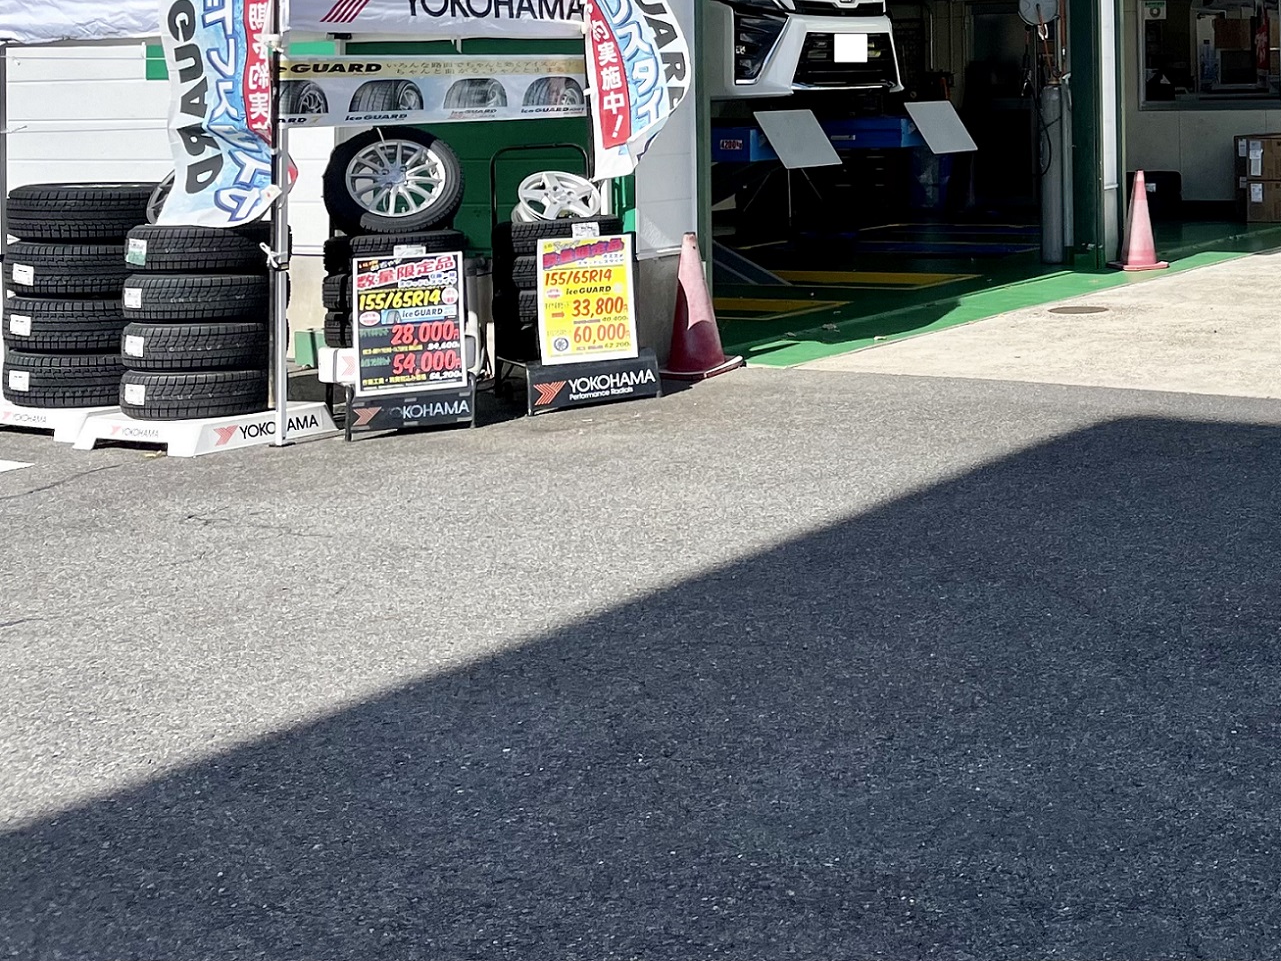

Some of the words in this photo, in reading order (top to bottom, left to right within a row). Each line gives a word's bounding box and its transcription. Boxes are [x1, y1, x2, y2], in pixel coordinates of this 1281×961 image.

[279, 62, 382, 74] eGUARD
[357, 256, 454, 288] 数量限定品
[545, 268, 612, 286] 155/65R14
[566, 285, 612, 295] iceGUARD
[359, 288, 442, 311] 155/65R14
[402, 308, 443, 318] iceGUARD
[568, 369, 656, 394] YOKOHAMA
[569, 389, 608, 401] Performance
[610, 387, 633, 397] Radials
[389, 400, 470, 419] OKOHAMA
[240, 415, 319, 439] YOKOAMA
